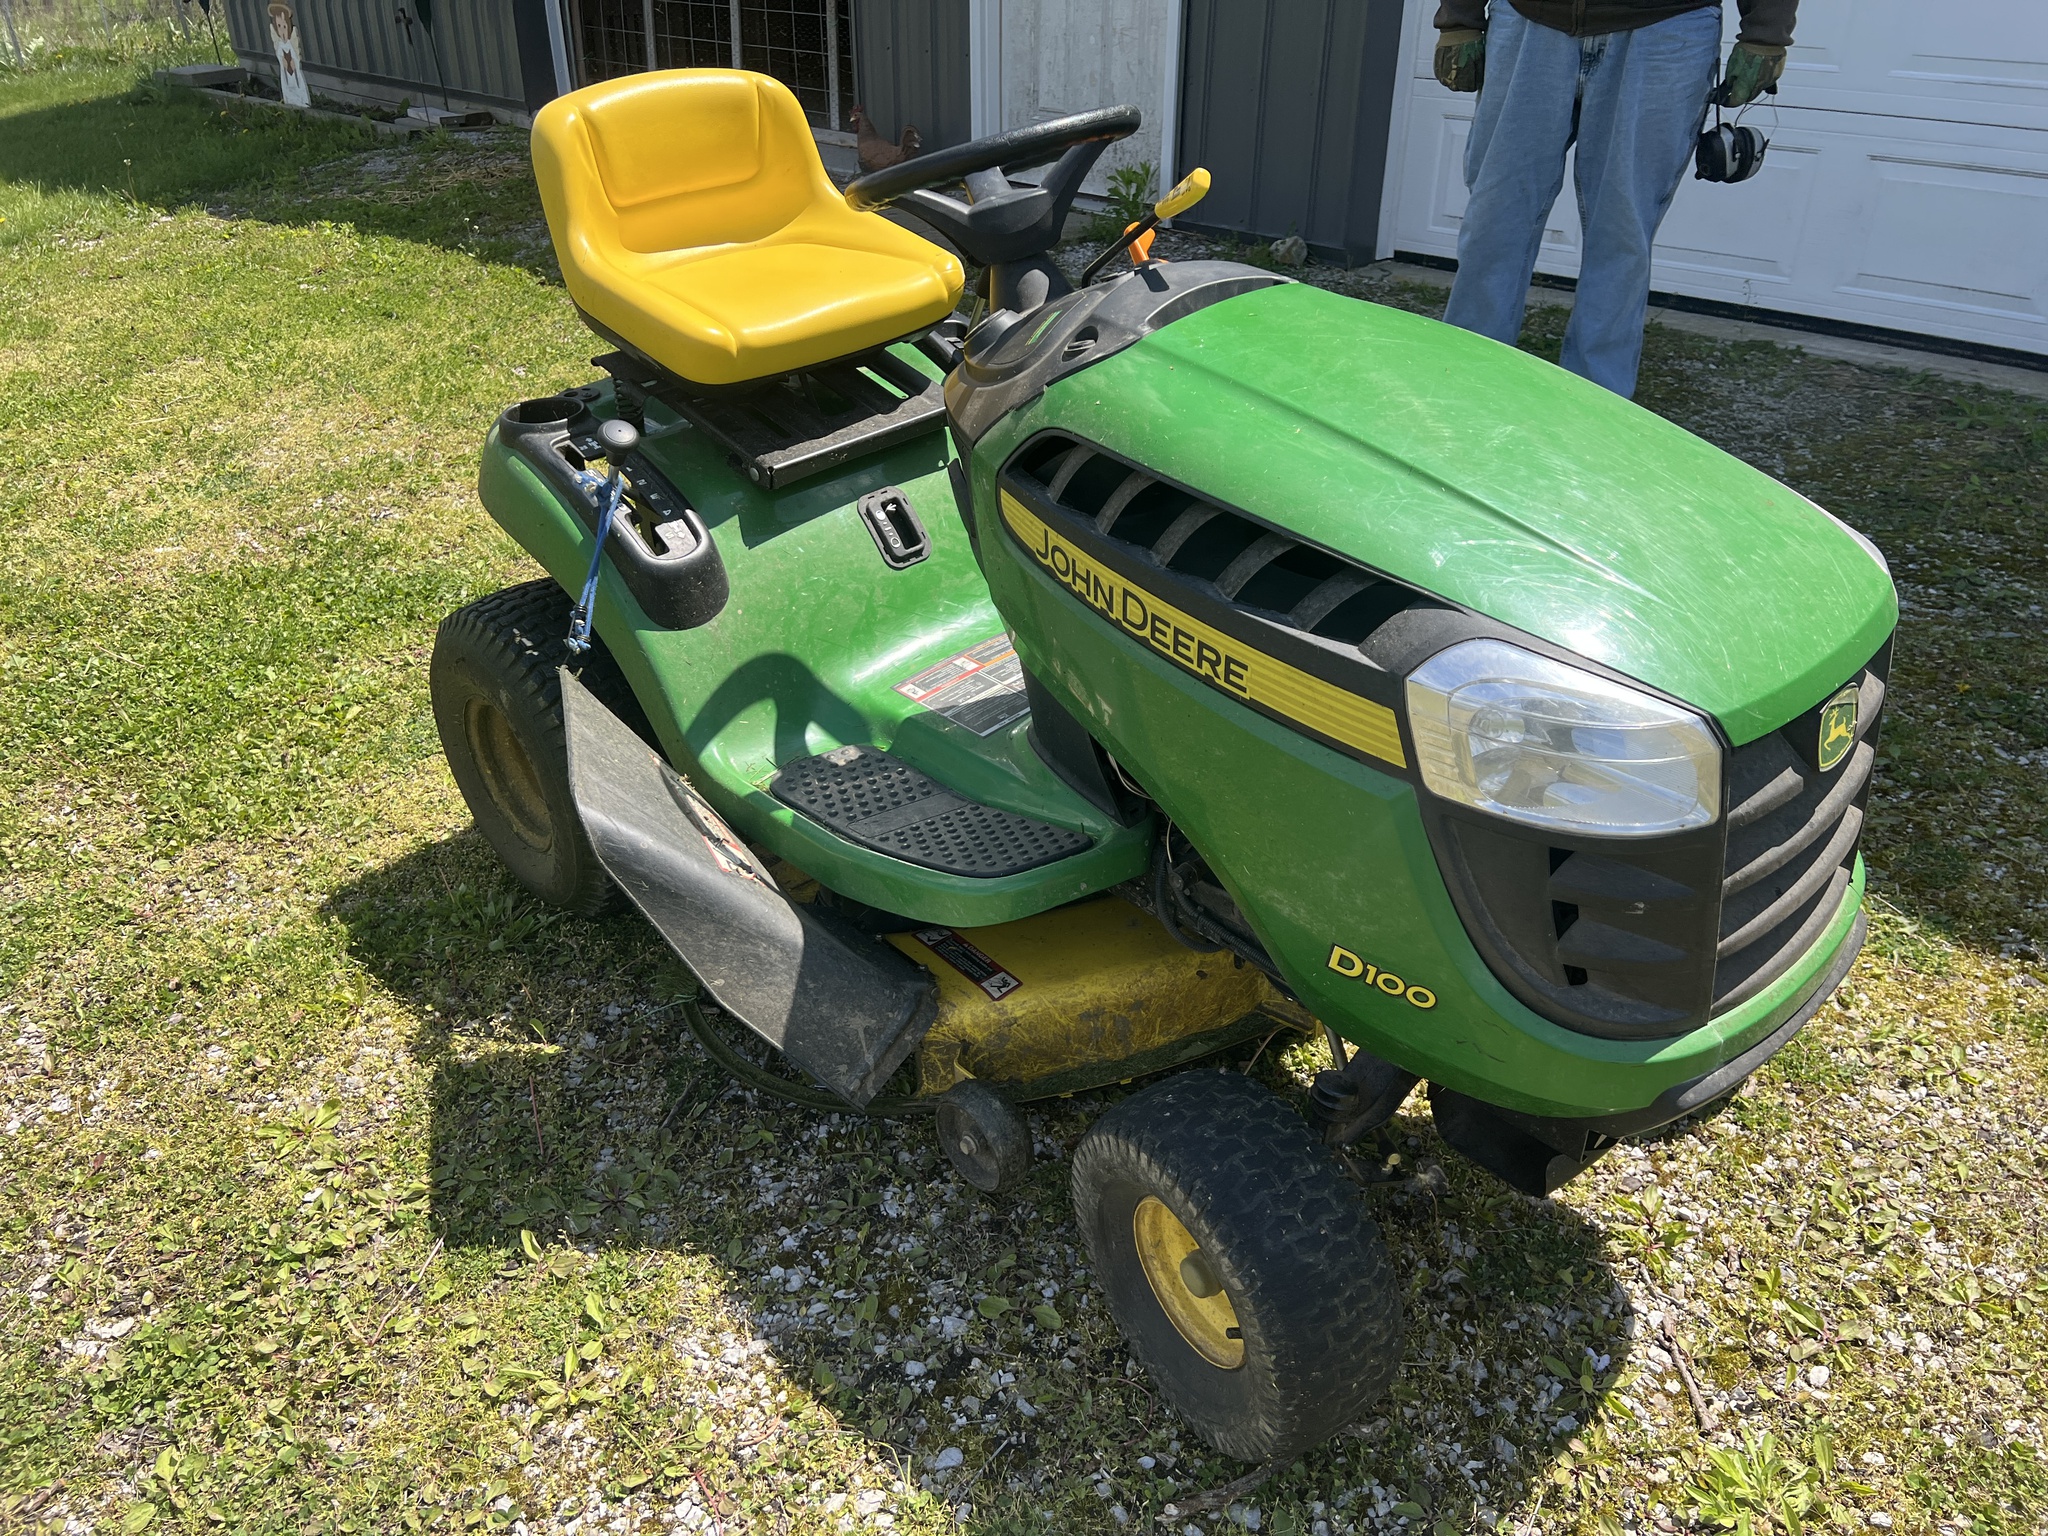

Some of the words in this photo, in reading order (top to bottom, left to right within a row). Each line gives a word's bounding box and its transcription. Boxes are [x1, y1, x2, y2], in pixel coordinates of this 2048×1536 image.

[1035, 530, 1115, 613] JOHN
[1122, 587, 1249, 694] DEERE
[969, 944, 992, 964] DANGER
[1327, 944, 1437, 1009] D100
